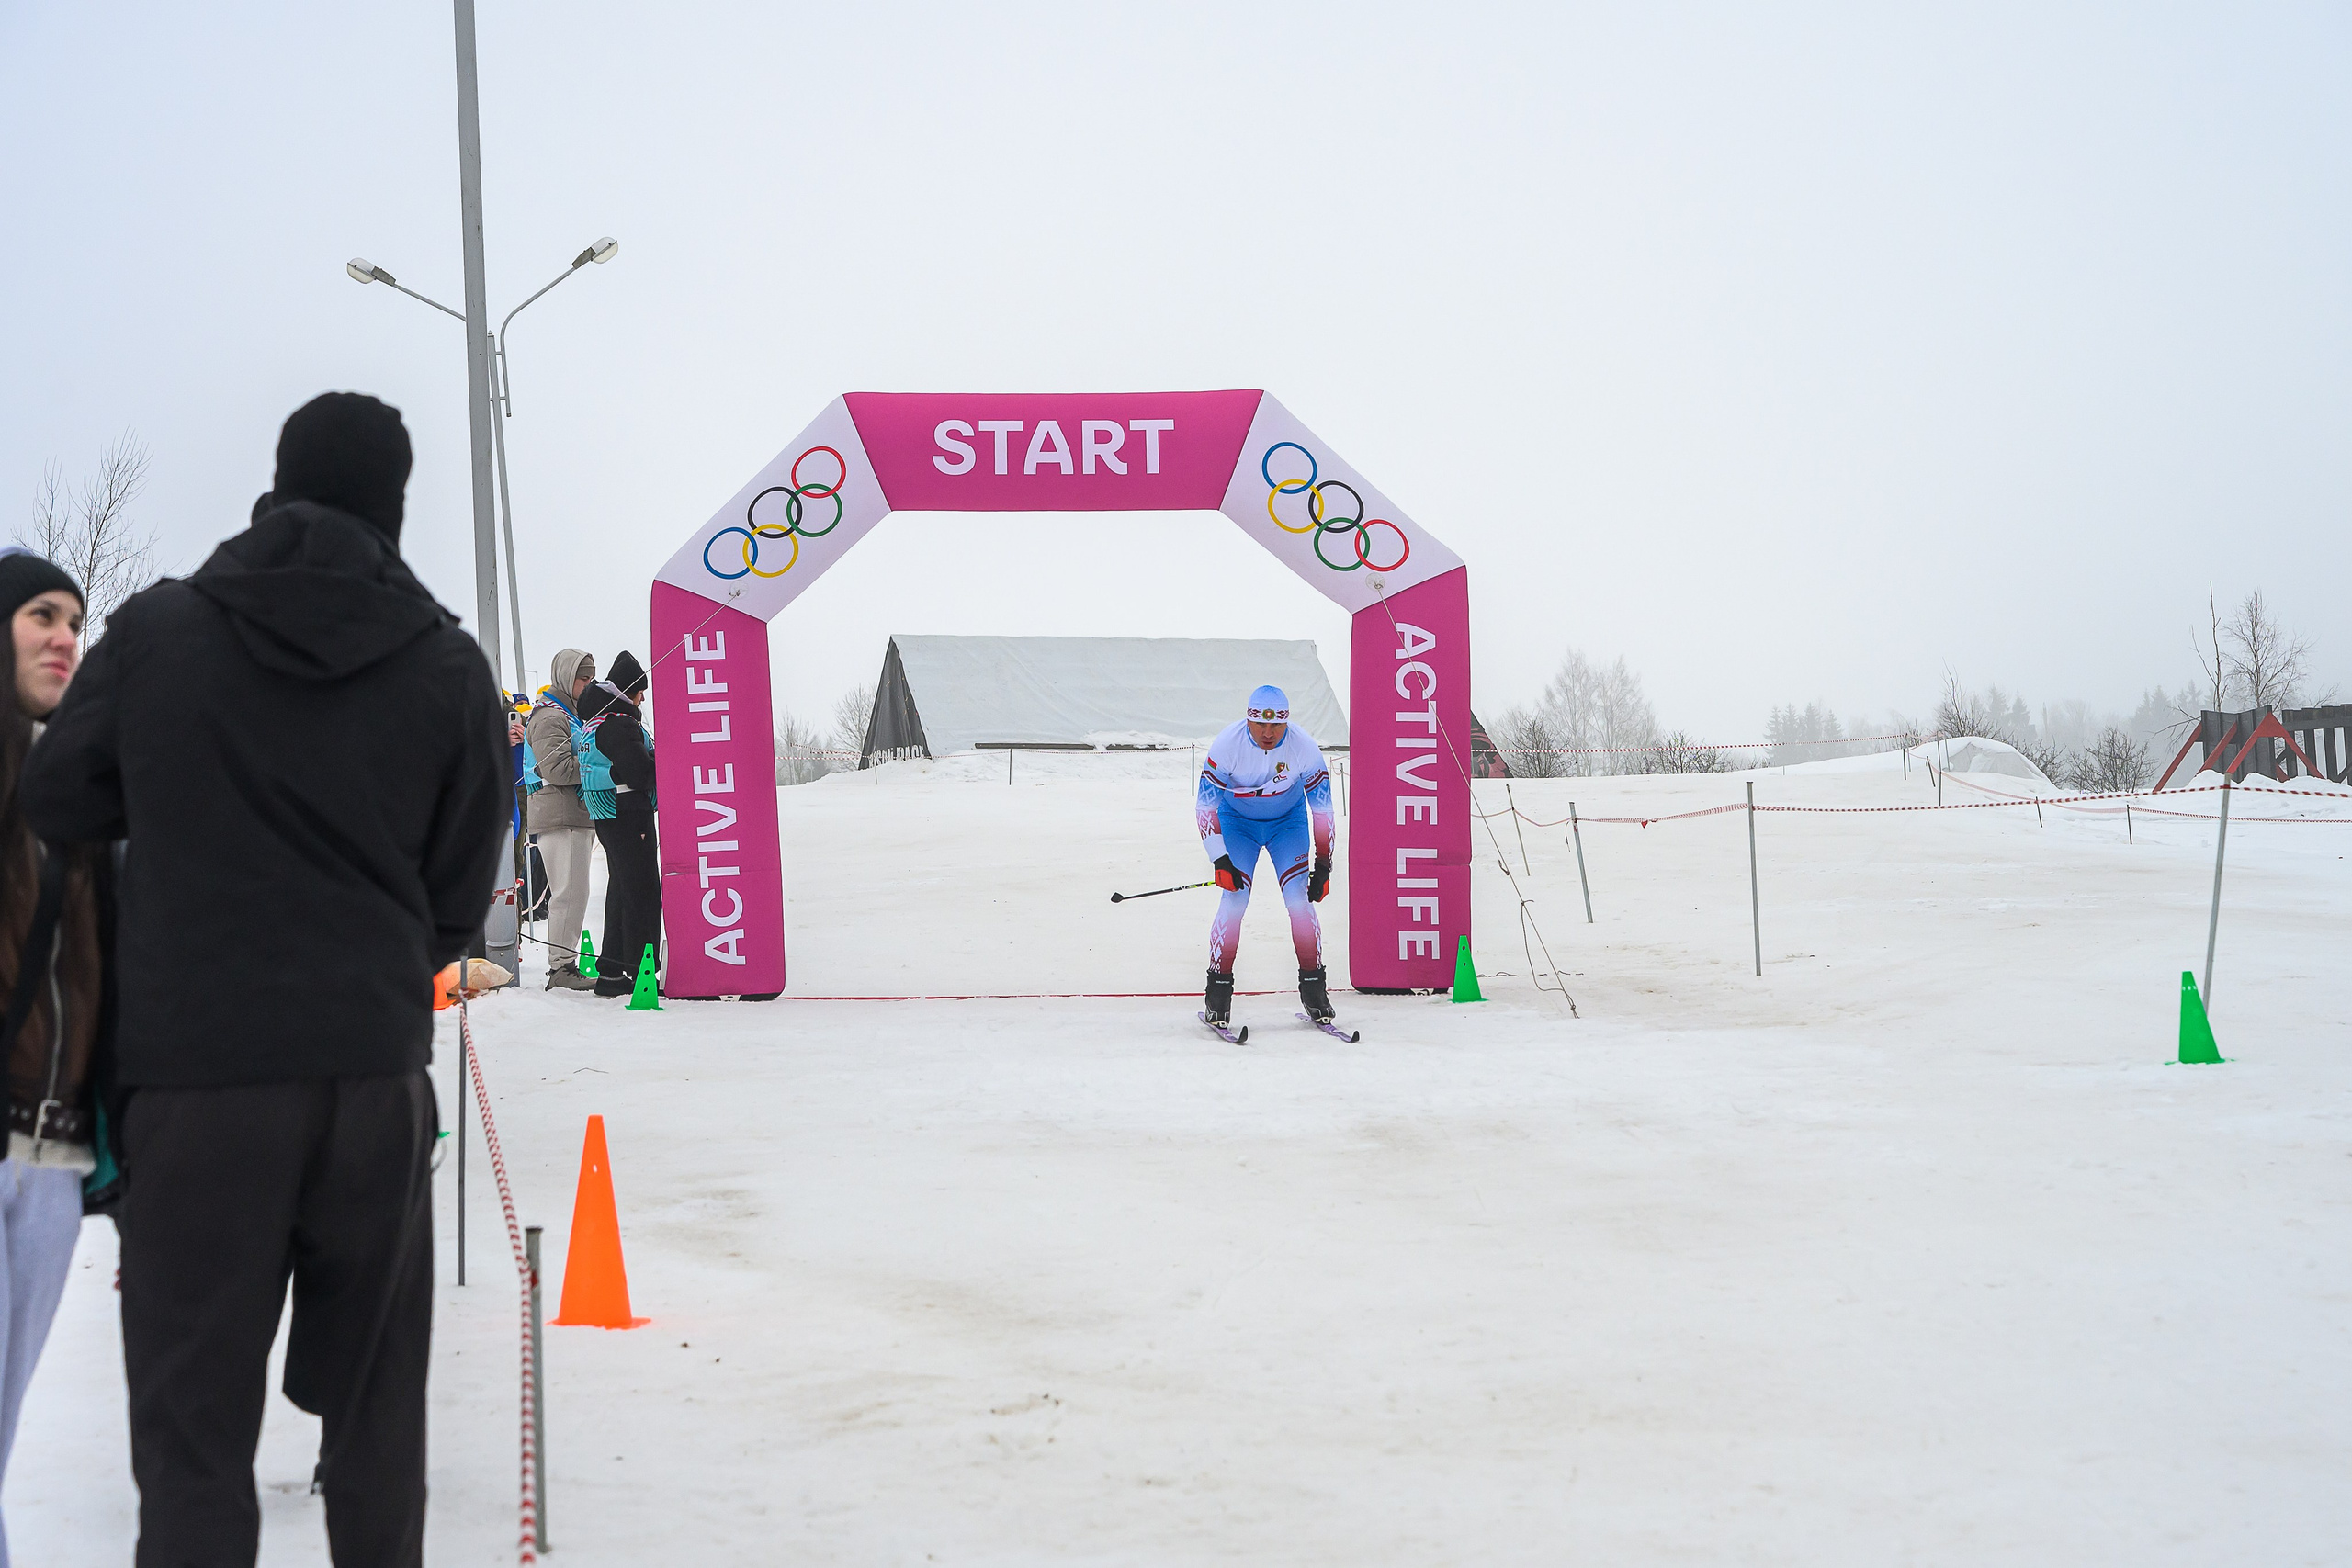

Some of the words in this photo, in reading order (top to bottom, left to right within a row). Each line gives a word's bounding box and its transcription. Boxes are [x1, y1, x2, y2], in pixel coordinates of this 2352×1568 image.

[933, 419, 1175, 477] START
[684, 630, 732, 744] LIFE
[1394, 622, 1439, 826] ACTIVE
[692, 762, 747, 966] ACTIVE
[1396, 847, 1442, 961] LIFE
